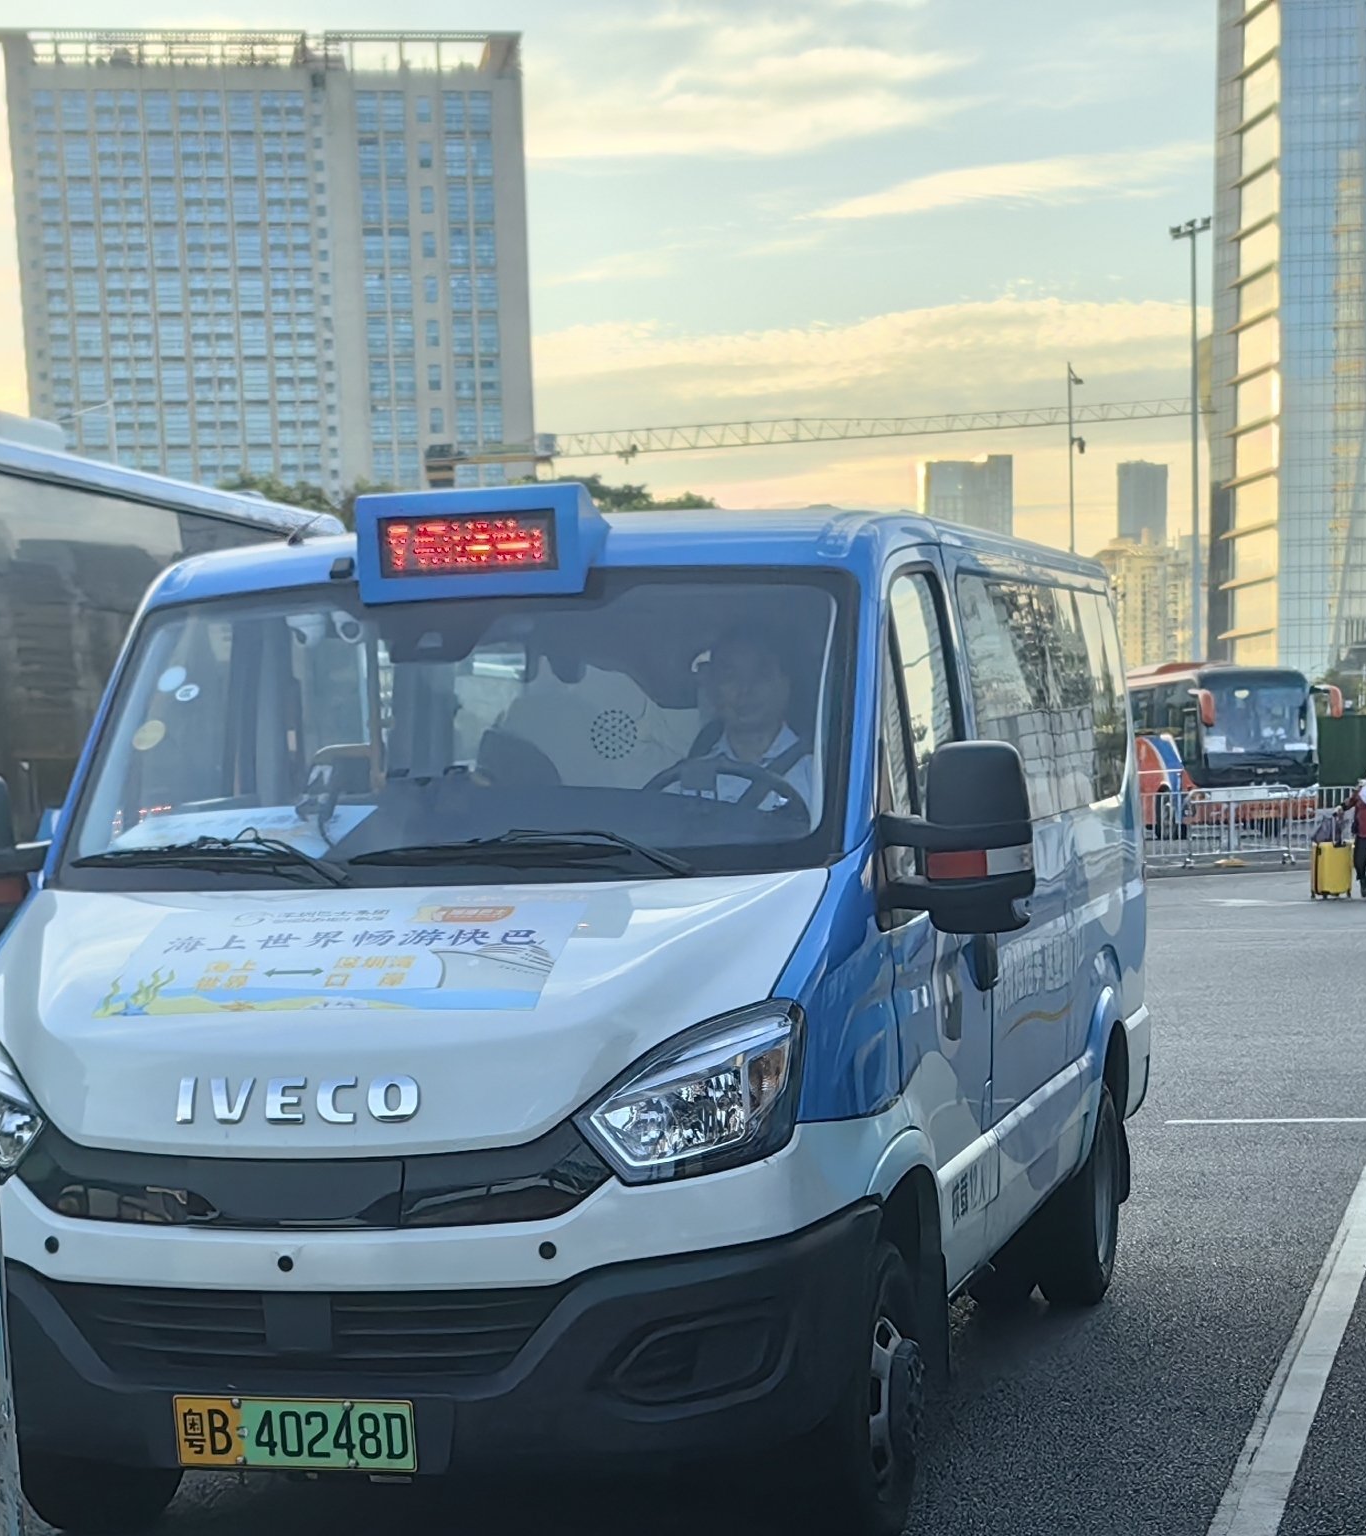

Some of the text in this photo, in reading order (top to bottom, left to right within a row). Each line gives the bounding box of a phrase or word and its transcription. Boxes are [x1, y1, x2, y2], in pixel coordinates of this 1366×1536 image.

[163, 928, 538, 954] 海上世界畅游快巴
[175, 1074, 421, 1124] IVECO
